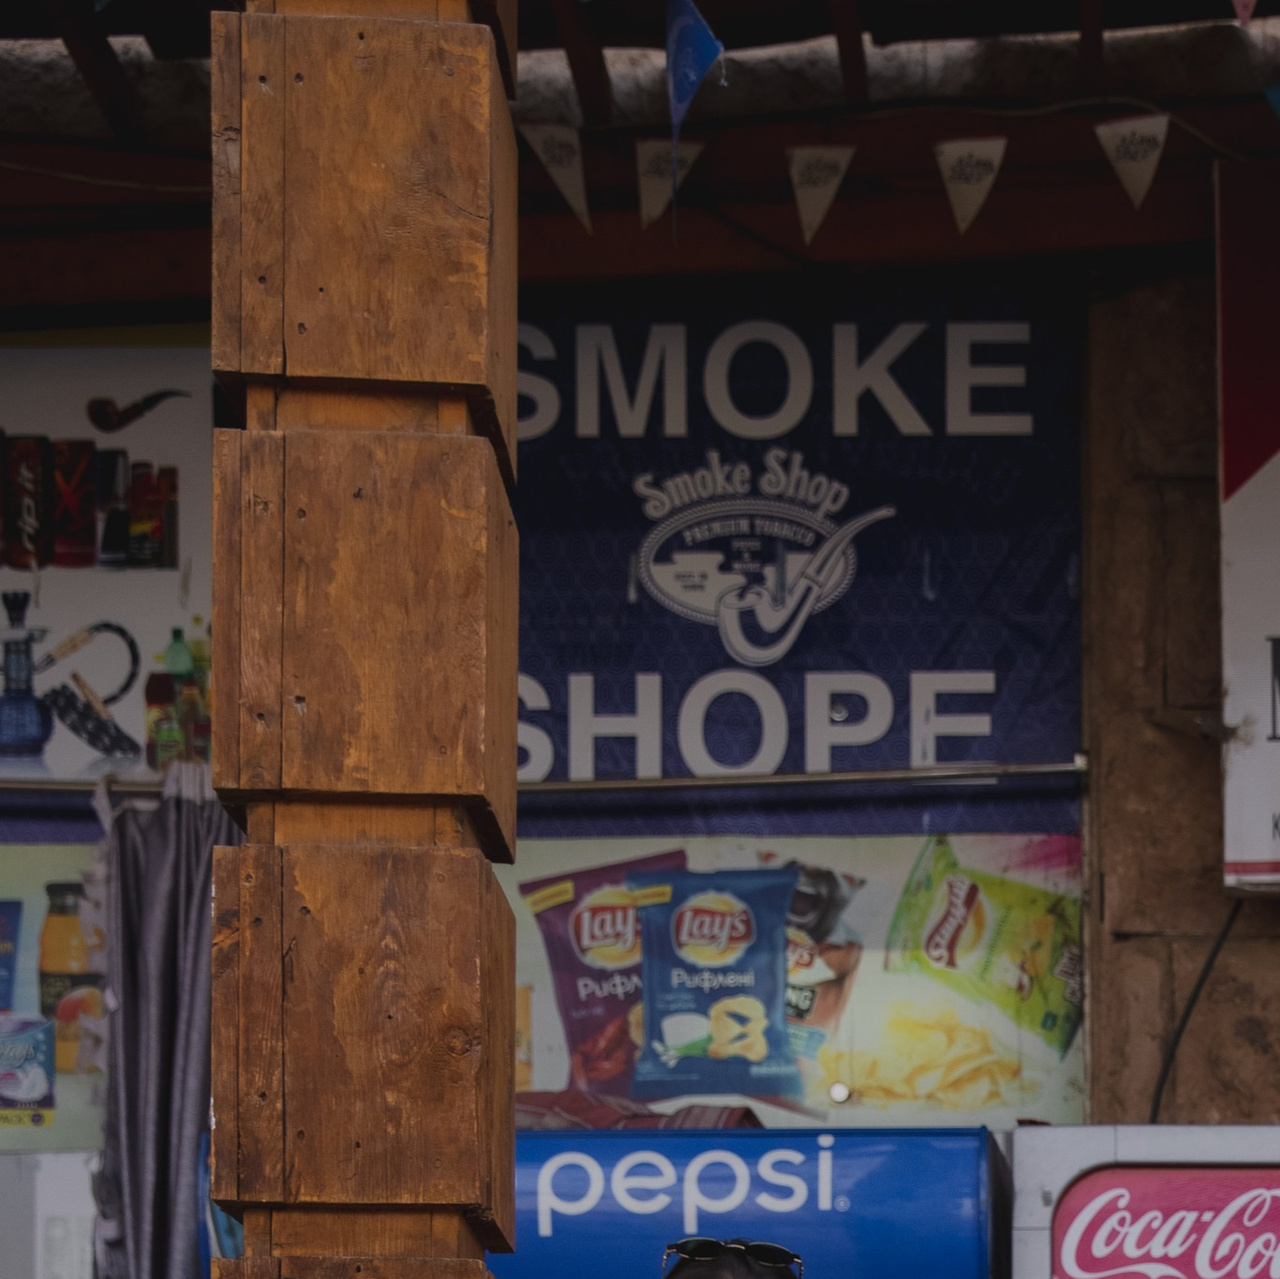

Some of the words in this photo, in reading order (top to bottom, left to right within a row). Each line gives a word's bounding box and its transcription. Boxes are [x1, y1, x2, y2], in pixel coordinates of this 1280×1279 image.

[632, 447, 751, 521] Smoke
[757, 444, 850, 521] Shop
[576, 906, 642, 950] Lay
[678, 908, 749, 953] Lay's
[577, 971, 643, 1001] Рифл
[537, 1133, 833, 1238] pepsi
